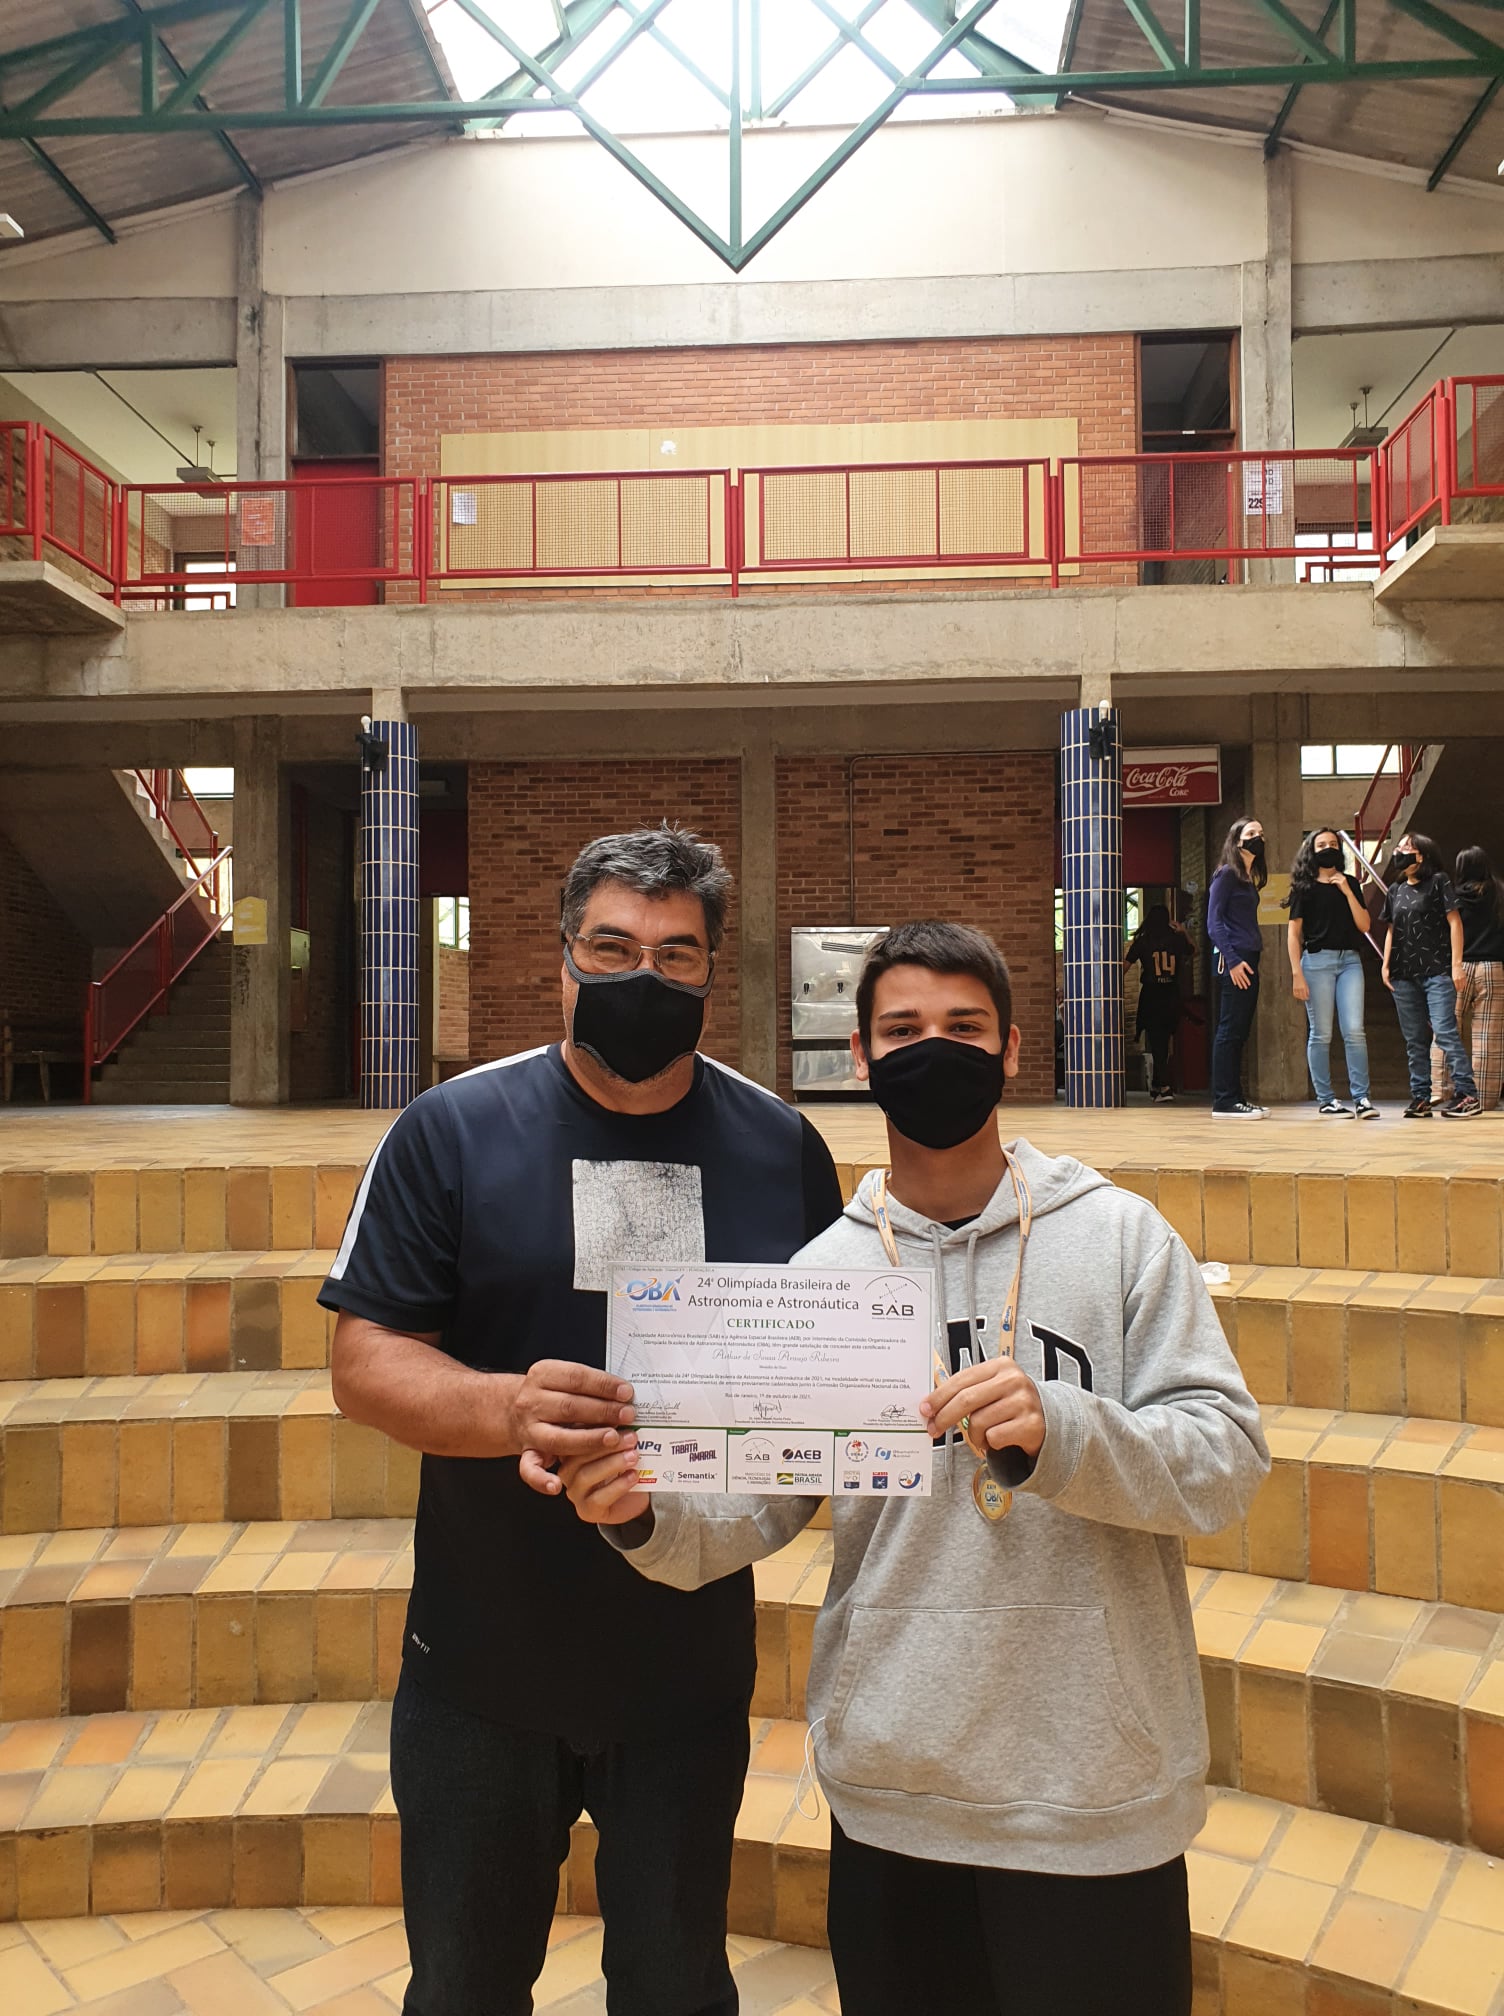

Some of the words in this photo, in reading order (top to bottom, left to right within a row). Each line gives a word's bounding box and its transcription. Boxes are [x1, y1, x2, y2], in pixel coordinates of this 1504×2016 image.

[1169, 788, 1189, 796] Coke
[1152, 951, 1175, 976] 14
[626, 1279, 681, 1301] OBA
[780, 1278, 832, 1290] Brasileira
[836, 1280, 851, 1290] de
[688, 1295, 762, 1307] Astronomia
[777, 1297, 859, 1310] Astronáutica
[871, 1304, 914, 1316] SAB
[727, 1318, 815, 1329] CERTIFICADO
[635, 1441, 662, 1452] NPq
[672, 1442, 698, 1455] TABATA
[689, 1450, 717, 1462] AMARAL
[794, 1450, 821, 1460] AEB
